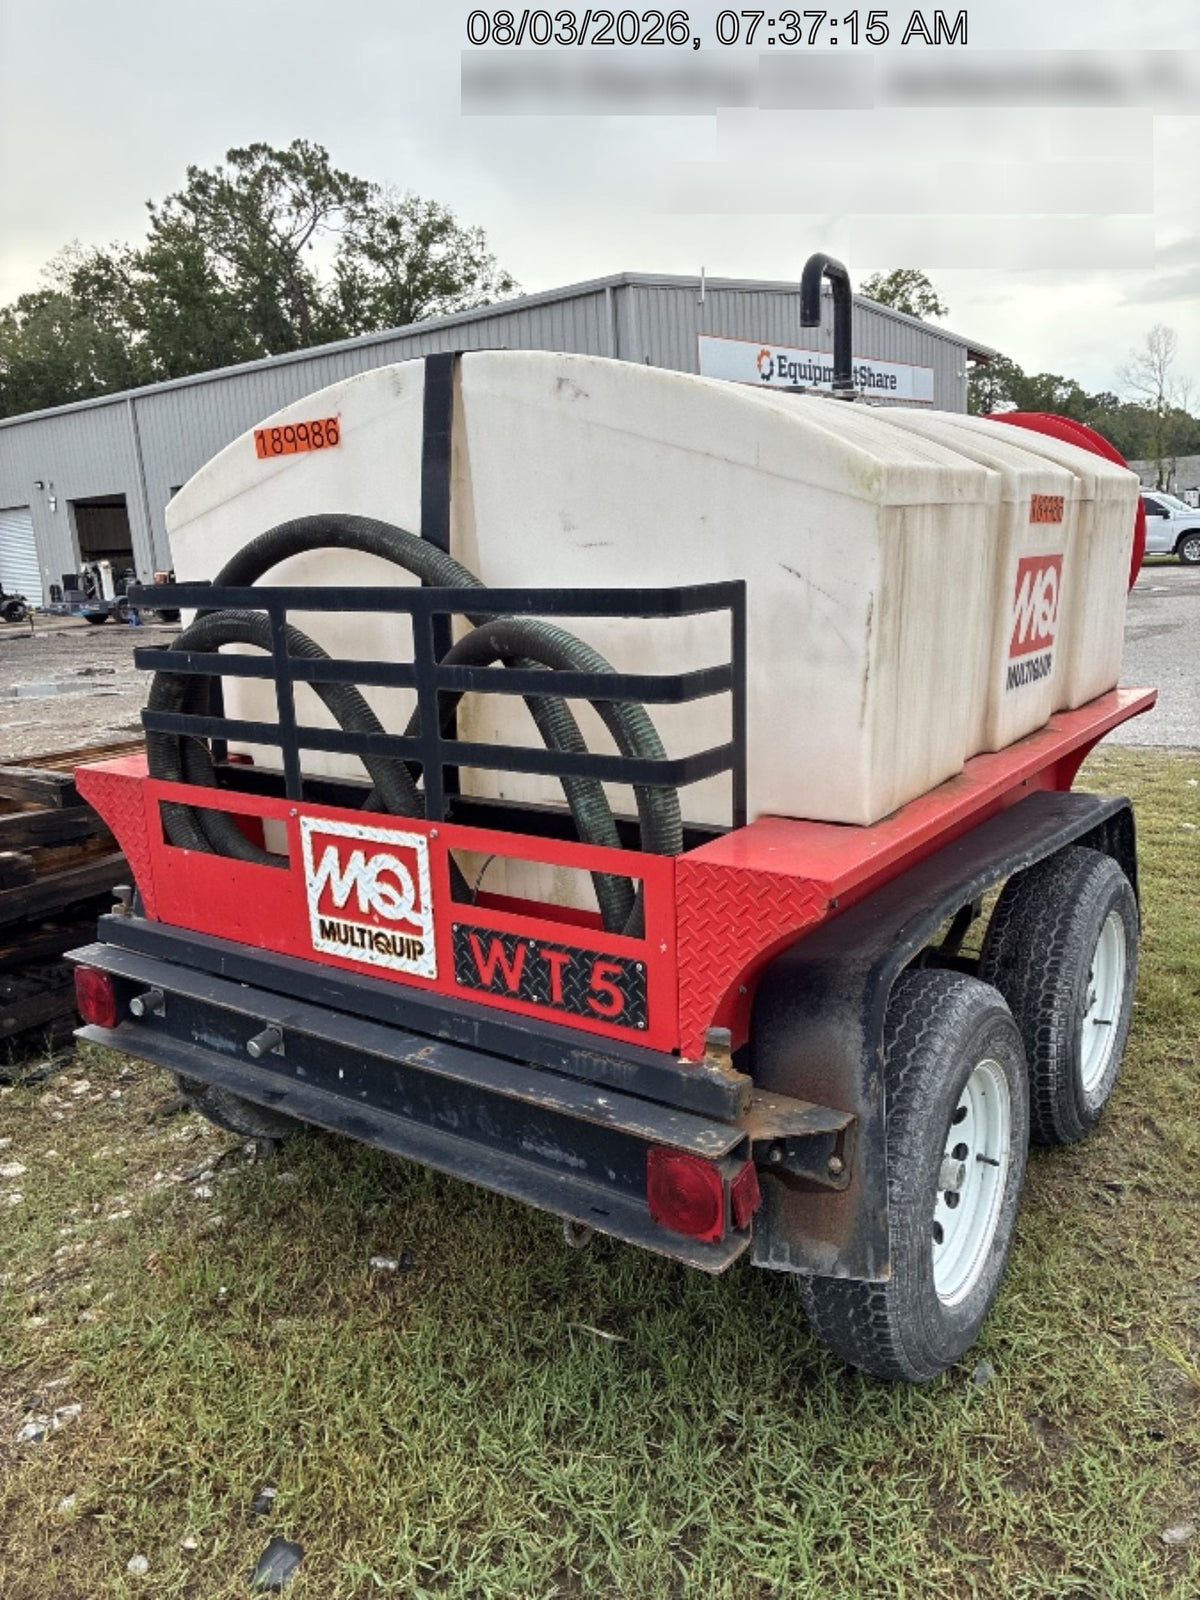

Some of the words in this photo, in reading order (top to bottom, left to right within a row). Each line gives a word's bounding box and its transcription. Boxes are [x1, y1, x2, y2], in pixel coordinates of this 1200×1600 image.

[777, 355, 897, 390] EquipmtShare
[256, 418, 339, 456] 189986
[1011, 565, 1058, 643] MQ
[312, 845, 424, 926] MQ
[319, 919, 424, 961] MULTIQUIP
